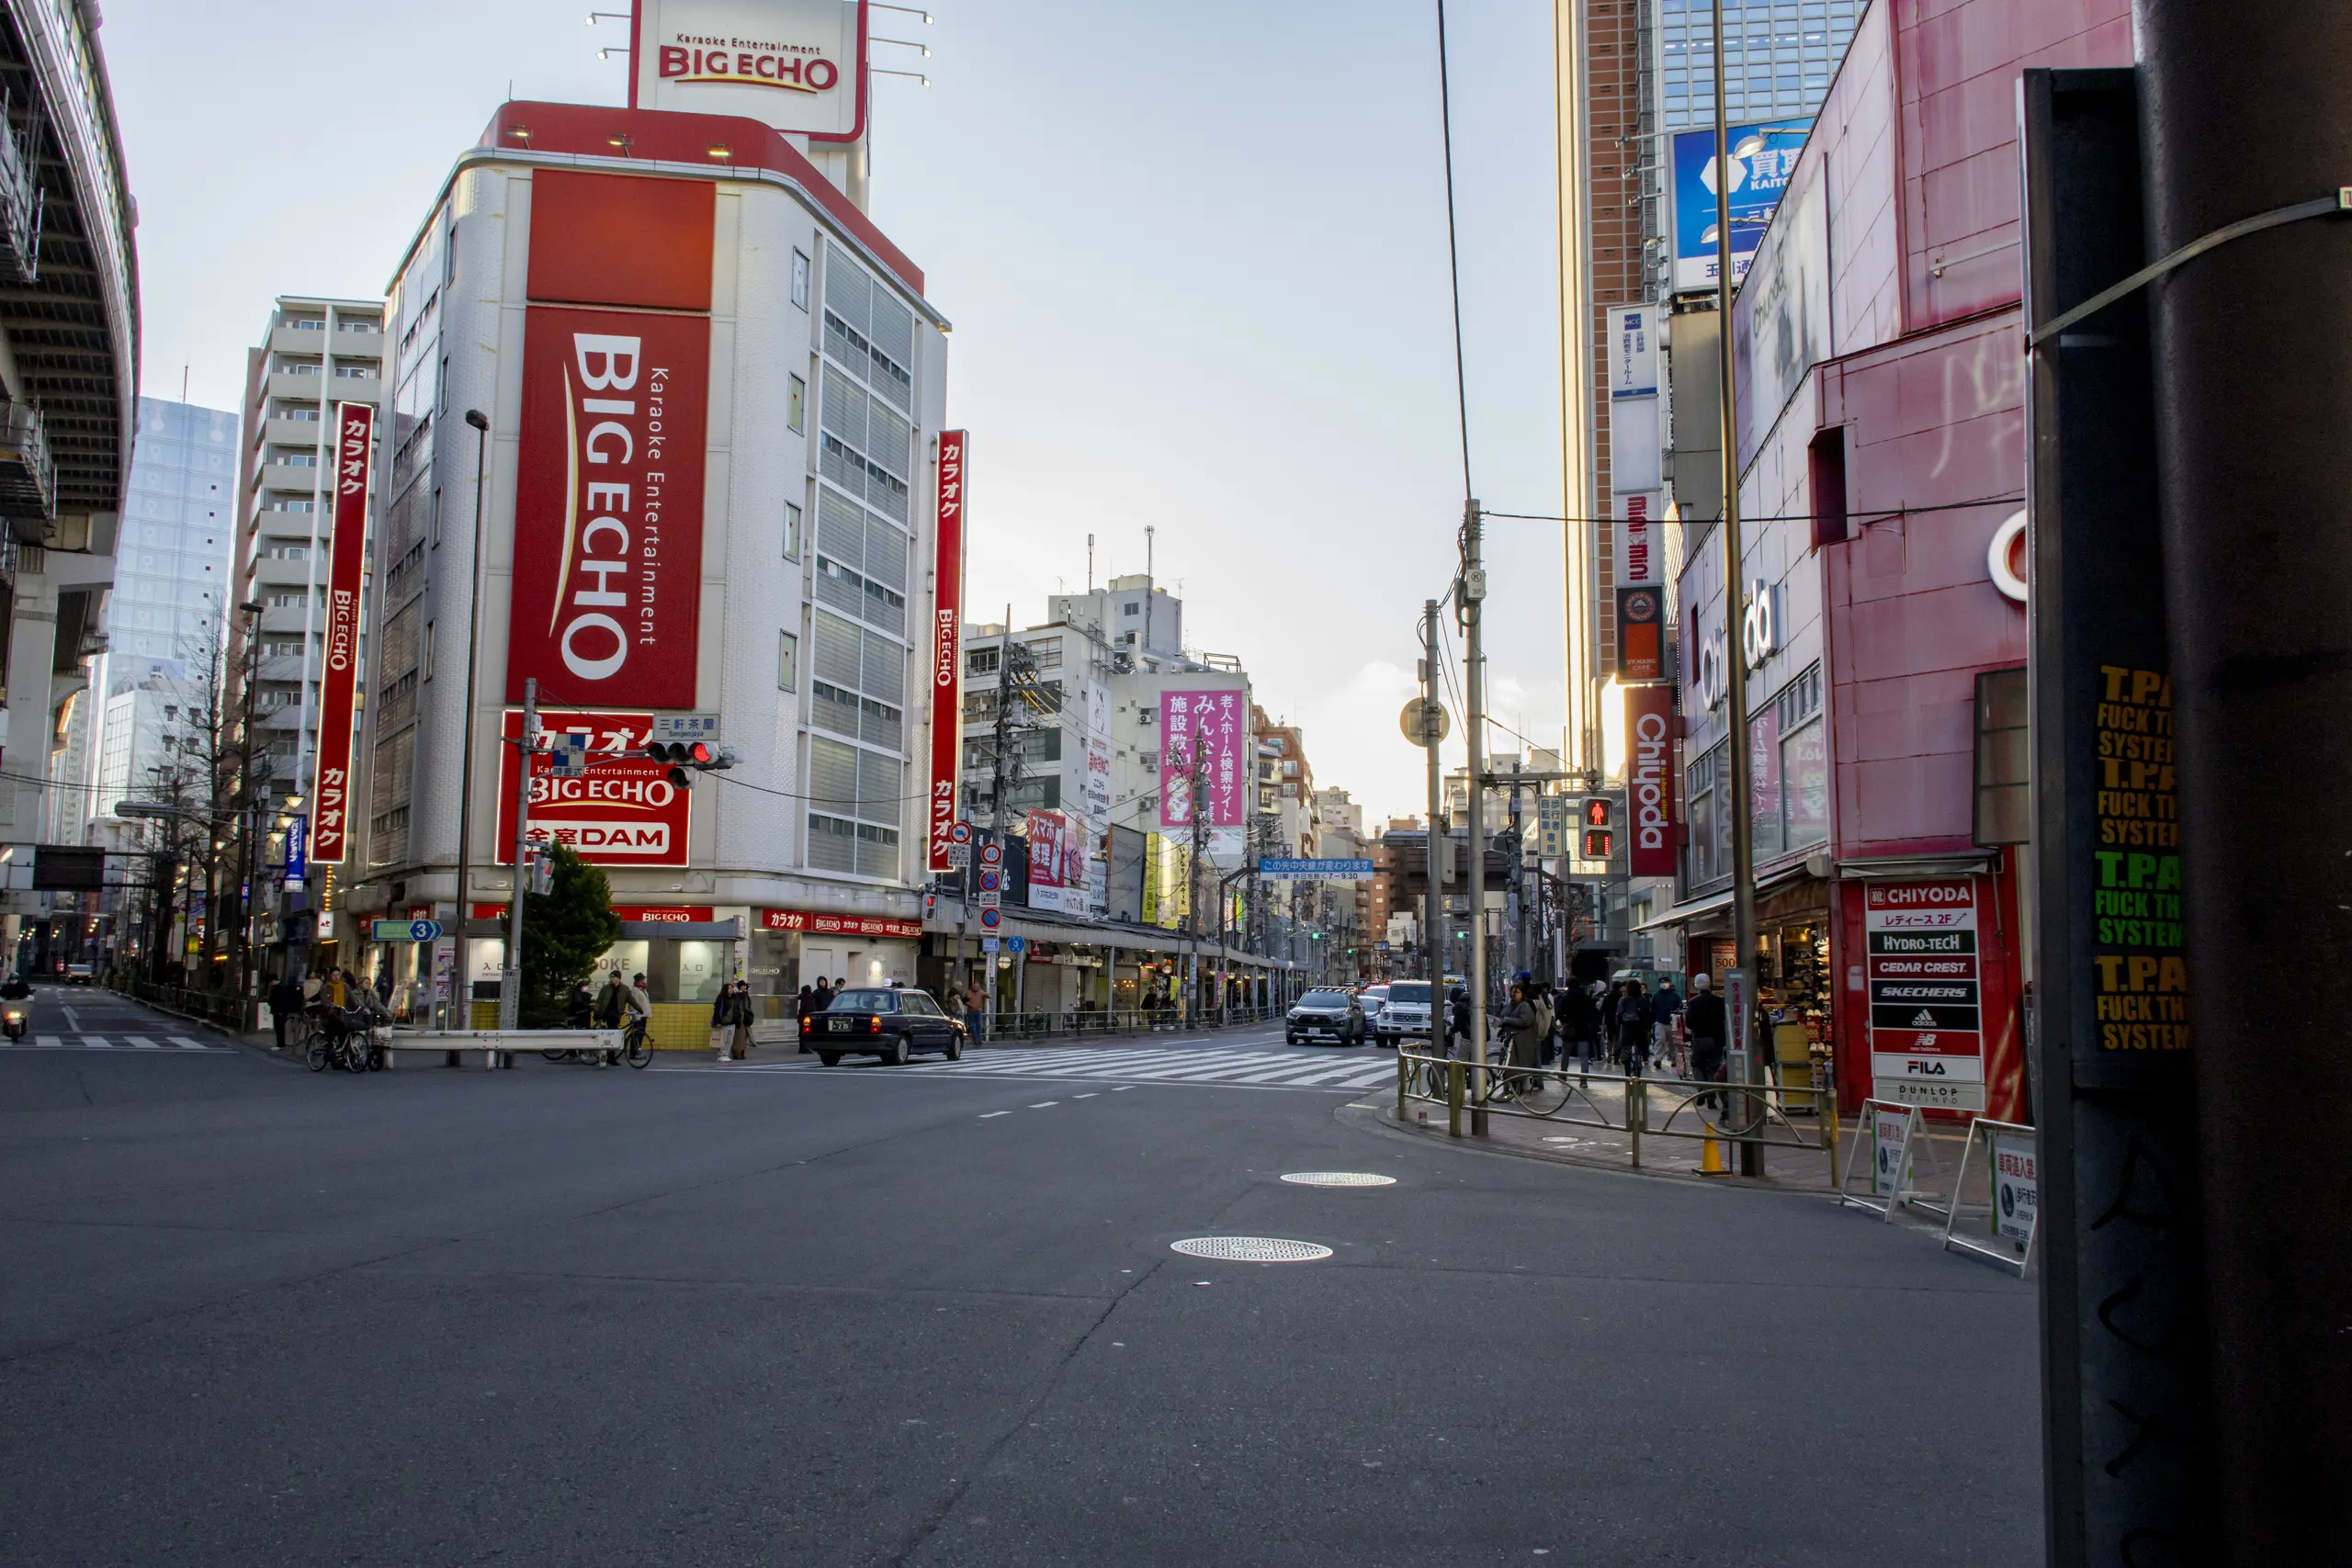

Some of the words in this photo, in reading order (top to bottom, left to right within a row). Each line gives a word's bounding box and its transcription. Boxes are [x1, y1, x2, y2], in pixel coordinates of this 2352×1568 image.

[676, 33, 726, 47] Karaoke
[731, 38, 821, 55] Entertainment
[659, 44, 729, 78] BIG
[737, 52, 839, 90] ECHO
[572, 333, 641, 464] BIG
[648, 367, 669, 460] Karaoke
[341, 420, 367, 495] カラオケ
[940, 444, 960, 518] カラオケ
[639, 472, 665, 646] Entertainment
[1628, 542, 1649, 581] mini
[560, 482, 630, 681] ECHO
[334, 590, 352, 622] BIG
[938, 609, 953, 639] BIG
[330, 624, 349, 671] ECHO
[937, 642, 952, 687] ECHO
[659, 718, 715, 730] 三軒茶屋
[1170, 695, 1188, 750] 施設数
[2097, 703, 2151, 734] FUCK
[668, 729, 704, 739] Sangenjaya
[1219, 694, 1234, 822] 老人ホーム検索サイト
[552, 767, 583, 777] 時差式
[584, 767, 660, 776] Entertainment
[1636, 713, 1668, 850] Chiyoda
[528, 777, 582, 804] BIG
[588, 779, 674, 807] ECHO
[2098, 790, 2151, 818] FUCK
[317, 767, 345, 847] カラオケ
[933, 779, 952, 857] カラオケ
[1541, 799, 1550, 830] 自転車
[1551, 798, 1560, 830] 歩行者
[1032, 816, 1055, 840] スマホ
[986, 850, 998, 859] 40
[1031, 840, 1050, 866] 修理
[1547, 832, 1555, 853] 専用
[1264, 860, 1369, 871] この先中央線が変わります
[1887, 886, 1970, 903] CHIYODA
[2096, 889, 2149, 918] FUCK
[416, 923, 427, 936] 3
[642, 912, 661, 922] BIG
[662, 913, 690, 922] ECHO
[771, 913, 803, 927] カラオケ
[815, 919, 827, 930] BIG
[826, 919, 840, 930] ECHO
[842, 921, 859, 930] カラオケ
[1885, 915, 1933, 925] レディース
[1938, 914, 1951, 924] 2F
[682, 964, 703, 972] 入口
[1715, 958, 1736, 968] 500
[1880, 963, 1921, 973] CEDAR
[1881, 987, 1967, 998] SKECHERS
[2097, 995, 2153, 1021] FUCK
[1912, 1019, 1937, 1027] adidas
[1907, 1060, 1946, 1076] FILA
[1899, 1085, 1958, 1097] DUNLOP
[1899, 1095, 1958, 1104] REFINED
